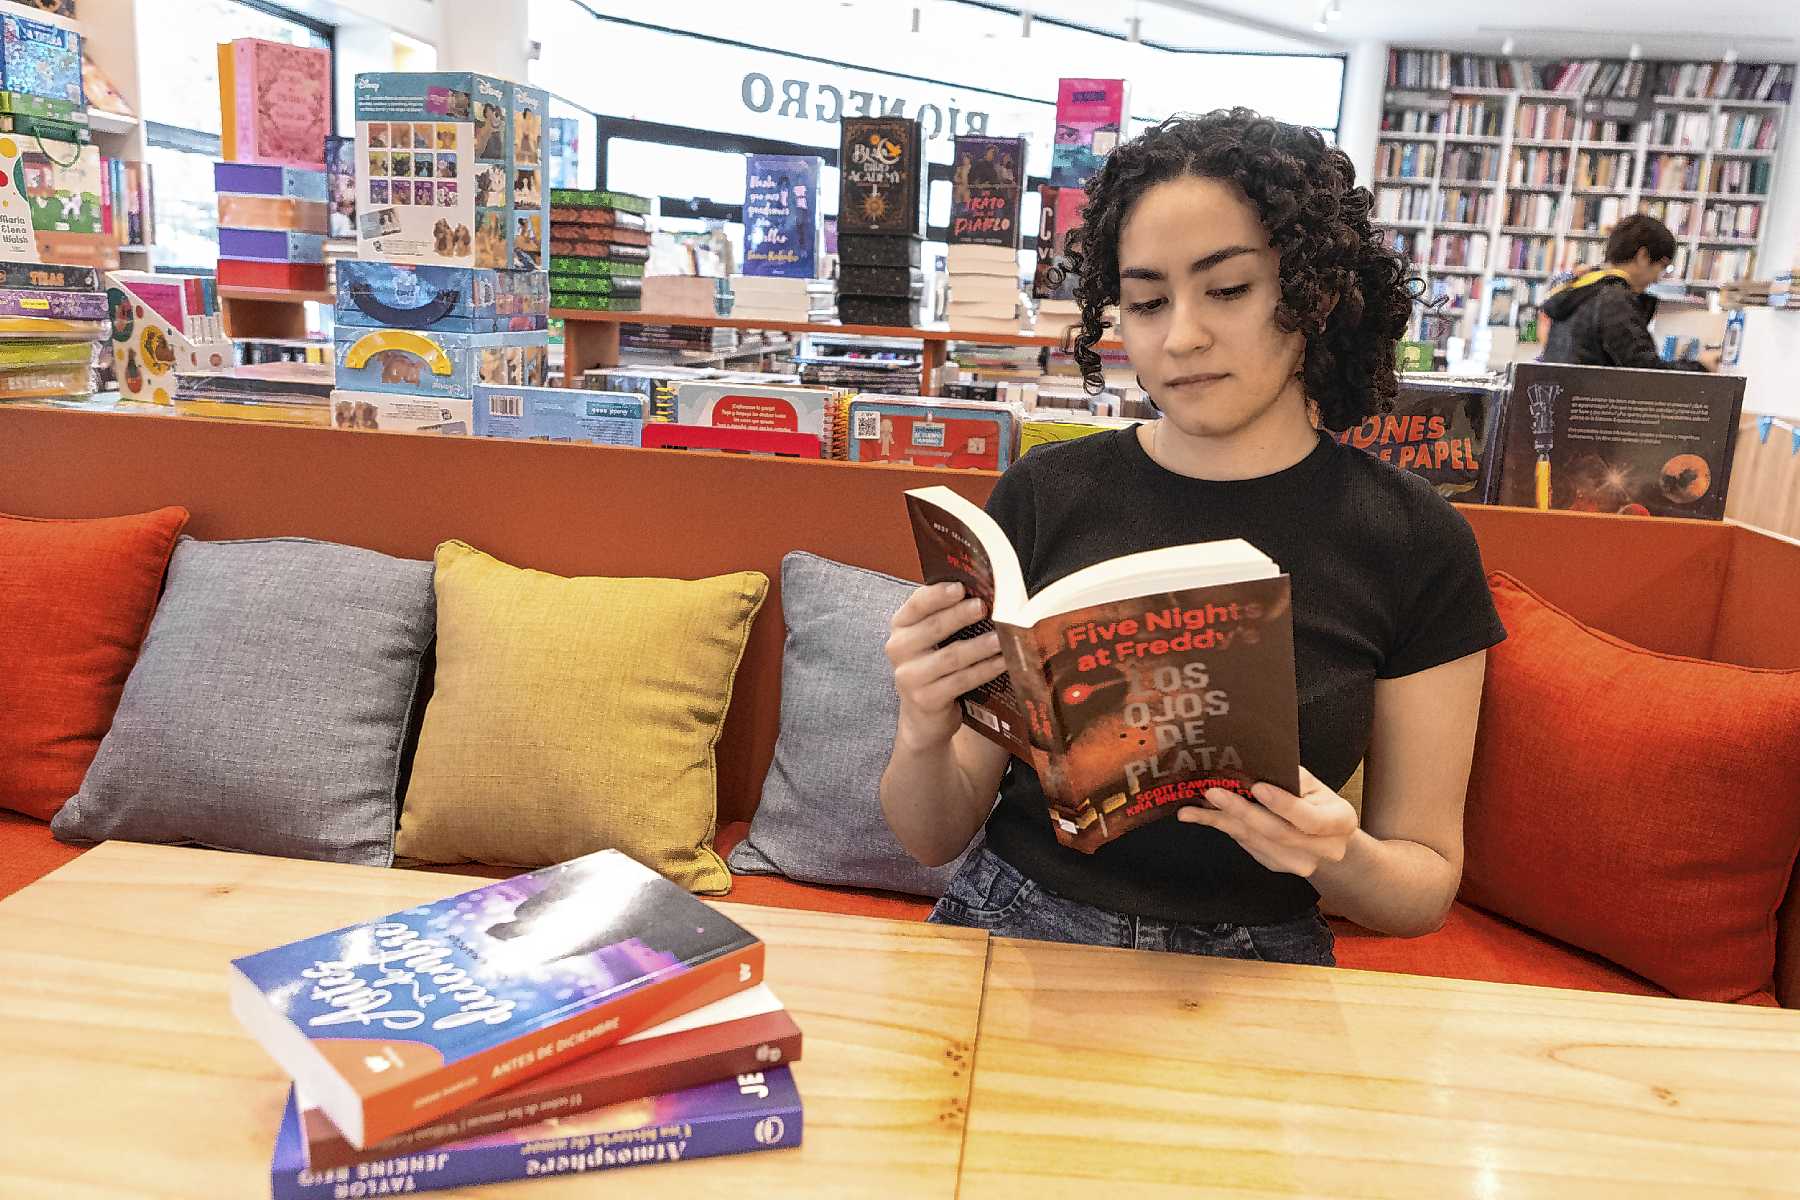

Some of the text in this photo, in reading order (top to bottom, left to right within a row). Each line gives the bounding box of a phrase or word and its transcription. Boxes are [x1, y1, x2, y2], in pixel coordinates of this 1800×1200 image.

[1, 225, 27, 234] Elena
[3, 235, 29, 244] Walsh
[1398, 437, 1480, 471] PAPEL
[1066, 602, 1263, 649] Five Nights
[1077, 626, 1261, 673] at Freddy's
[1128, 661, 1210, 697] LOS
[1123, 690, 1230, 728] OJOS
[1154, 720, 1207, 752] DE
[1123, 746, 1243, 796] PLATA
[1136, 779, 1241, 801] SCOTT CAWTHON
[491, 1016, 620, 1078] ANTES DE DICIEMBRE
[356, 1152, 450, 1180] JENKINS
[526, 1140, 687, 1176] Atmosphere
[334, 1176, 417, 1199] TAYLOR
